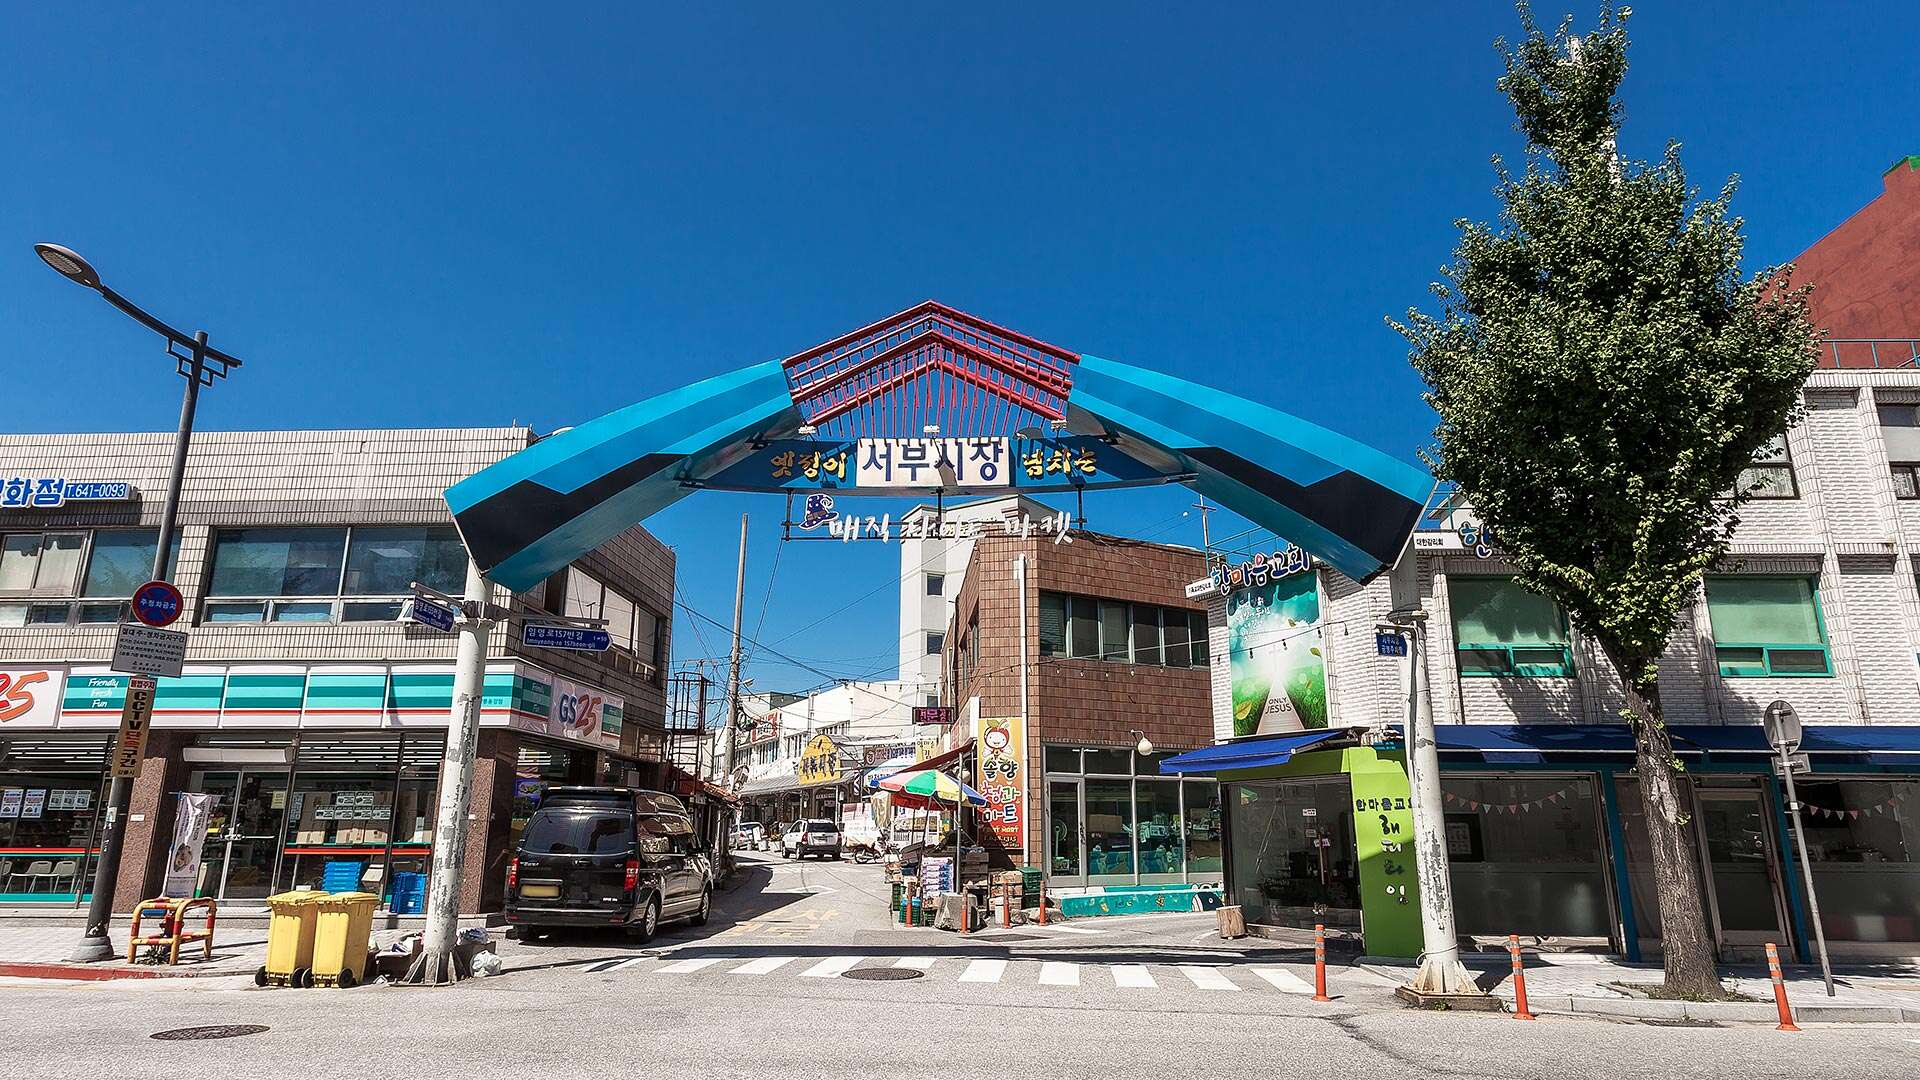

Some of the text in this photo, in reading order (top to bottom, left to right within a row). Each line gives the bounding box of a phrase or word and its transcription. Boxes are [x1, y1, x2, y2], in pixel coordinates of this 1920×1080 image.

[861, 441, 1004, 482] 서부시장
[1022, 446, 1097, 477] 넘치는
[0, 477, 125, 507] 화점 T.641-0093
[828, 512, 891, 545] 매직
[1004, 510, 1074, 546] 마켓
[1210, 542, 1310, 596] 한마음교회
[528, 627, 584, 640] 임영로157번길
[88, 678, 119, 688] Friendly
[91, 688, 113, 697] Fresh
[92, 698, 108, 708] Fun
[1265, 703, 1292, 714] JESUS
[1268, 696, 1288, 705] ONLY
[559, 693, 602, 737] GS25
[983, 757, 1018, 779] 솔향
[981, 780, 1021, 804] 청과
[982, 803, 1019, 823] 마트
